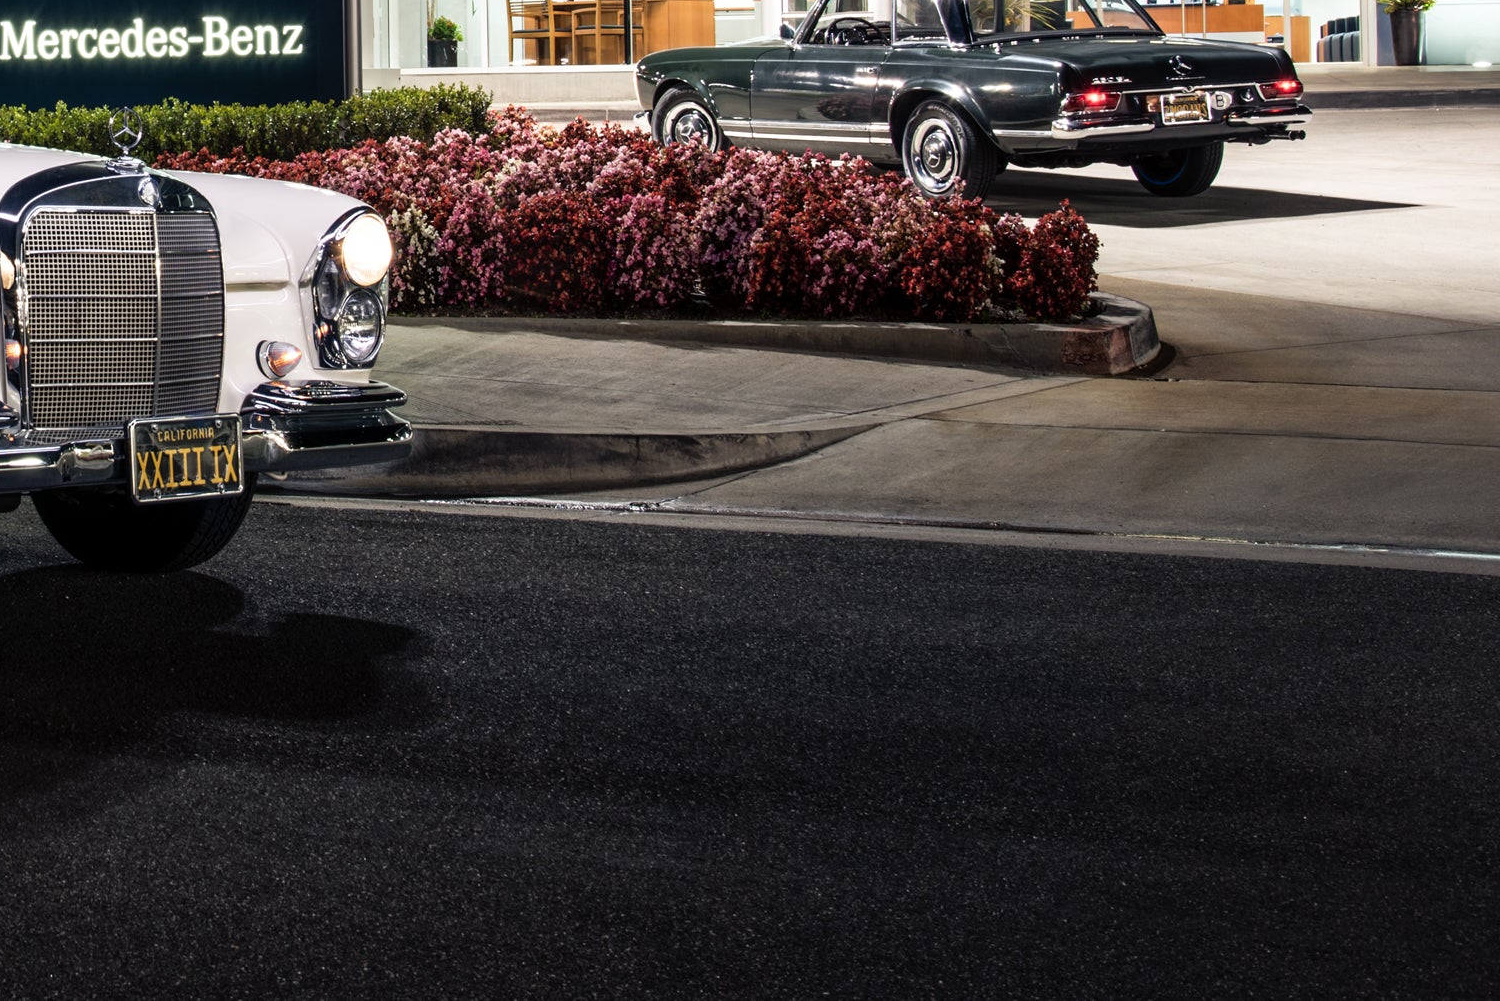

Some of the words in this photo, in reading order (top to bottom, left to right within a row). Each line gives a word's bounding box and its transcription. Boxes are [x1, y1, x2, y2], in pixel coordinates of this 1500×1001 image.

[0, 16, 303, 60] Mercedes-Benz
[1215, 95, 1224, 108] B
[157, 427, 215, 442] CALIFORNIA
